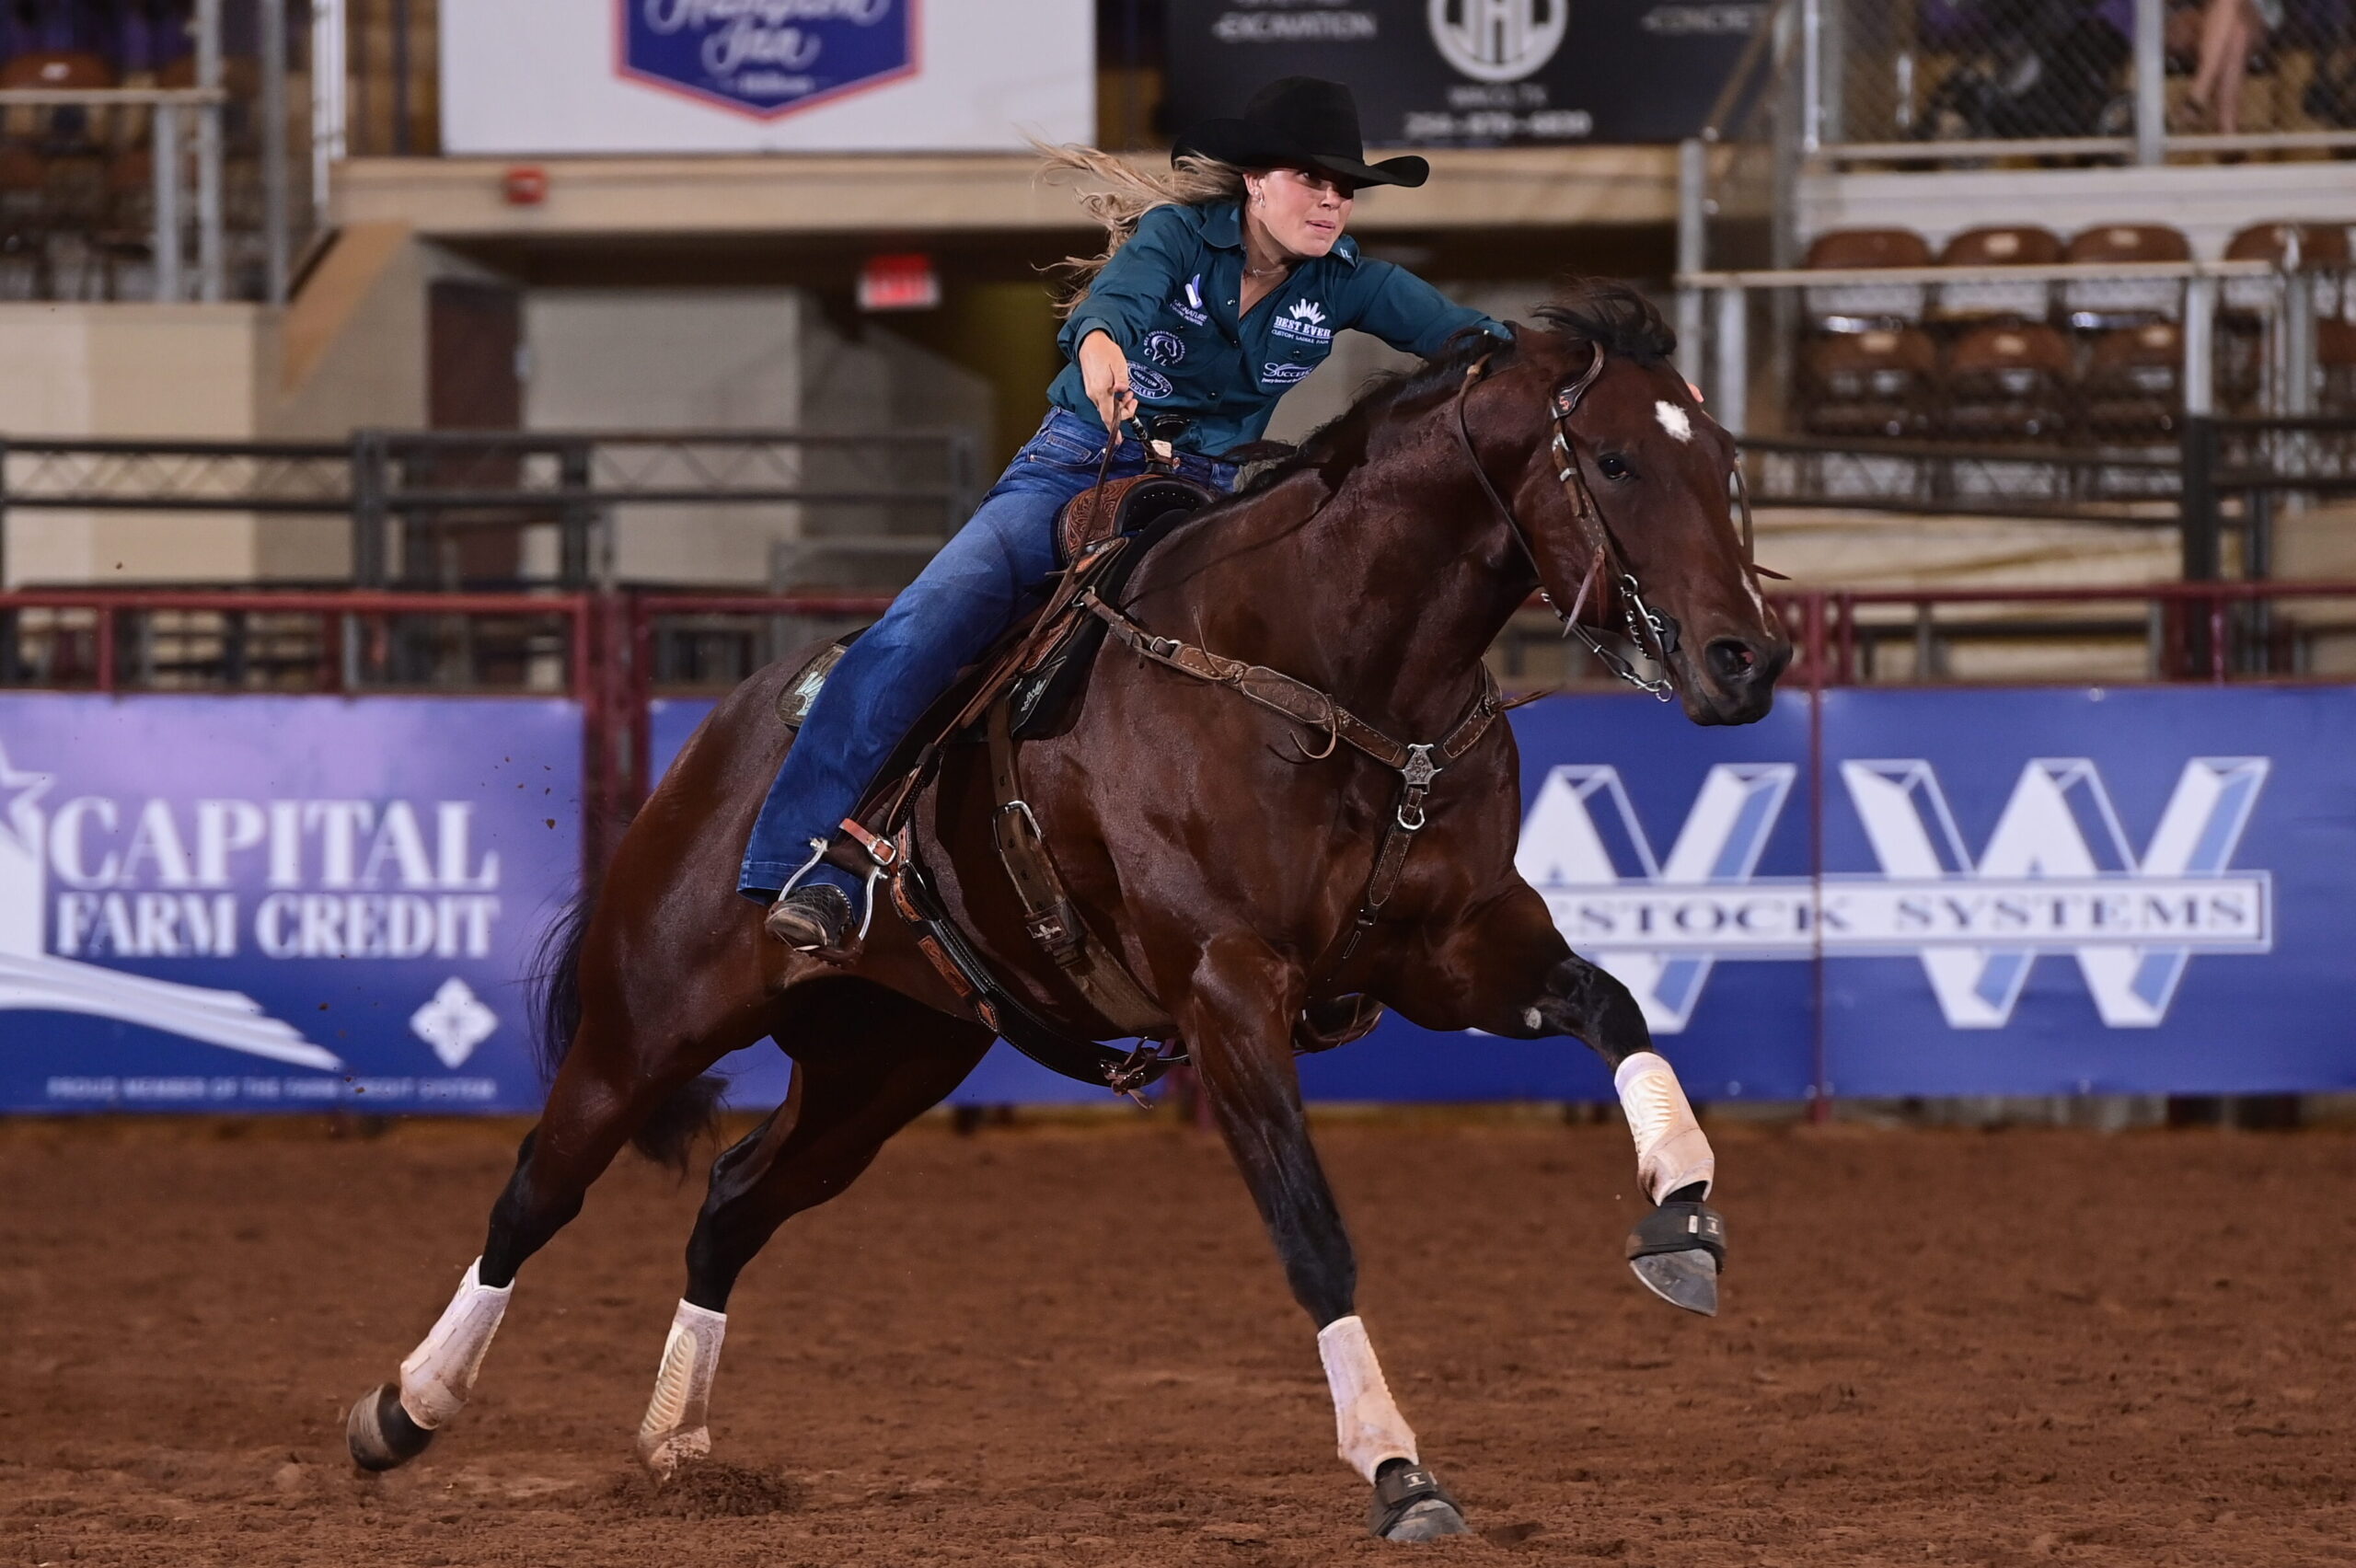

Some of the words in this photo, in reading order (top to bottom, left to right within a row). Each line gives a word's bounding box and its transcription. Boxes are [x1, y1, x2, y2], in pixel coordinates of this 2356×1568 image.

[1271, 329, 1295, 340] CUSTOM
[1274, 316, 1302, 331] BEST
[1302, 323, 1332, 338] EVER
[50, 795, 500, 891] CAPITAL
[56, 892, 238, 958] FARM
[255, 892, 502, 960] CREDIT
[1897, 892, 2247, 931] SYSTEMS
